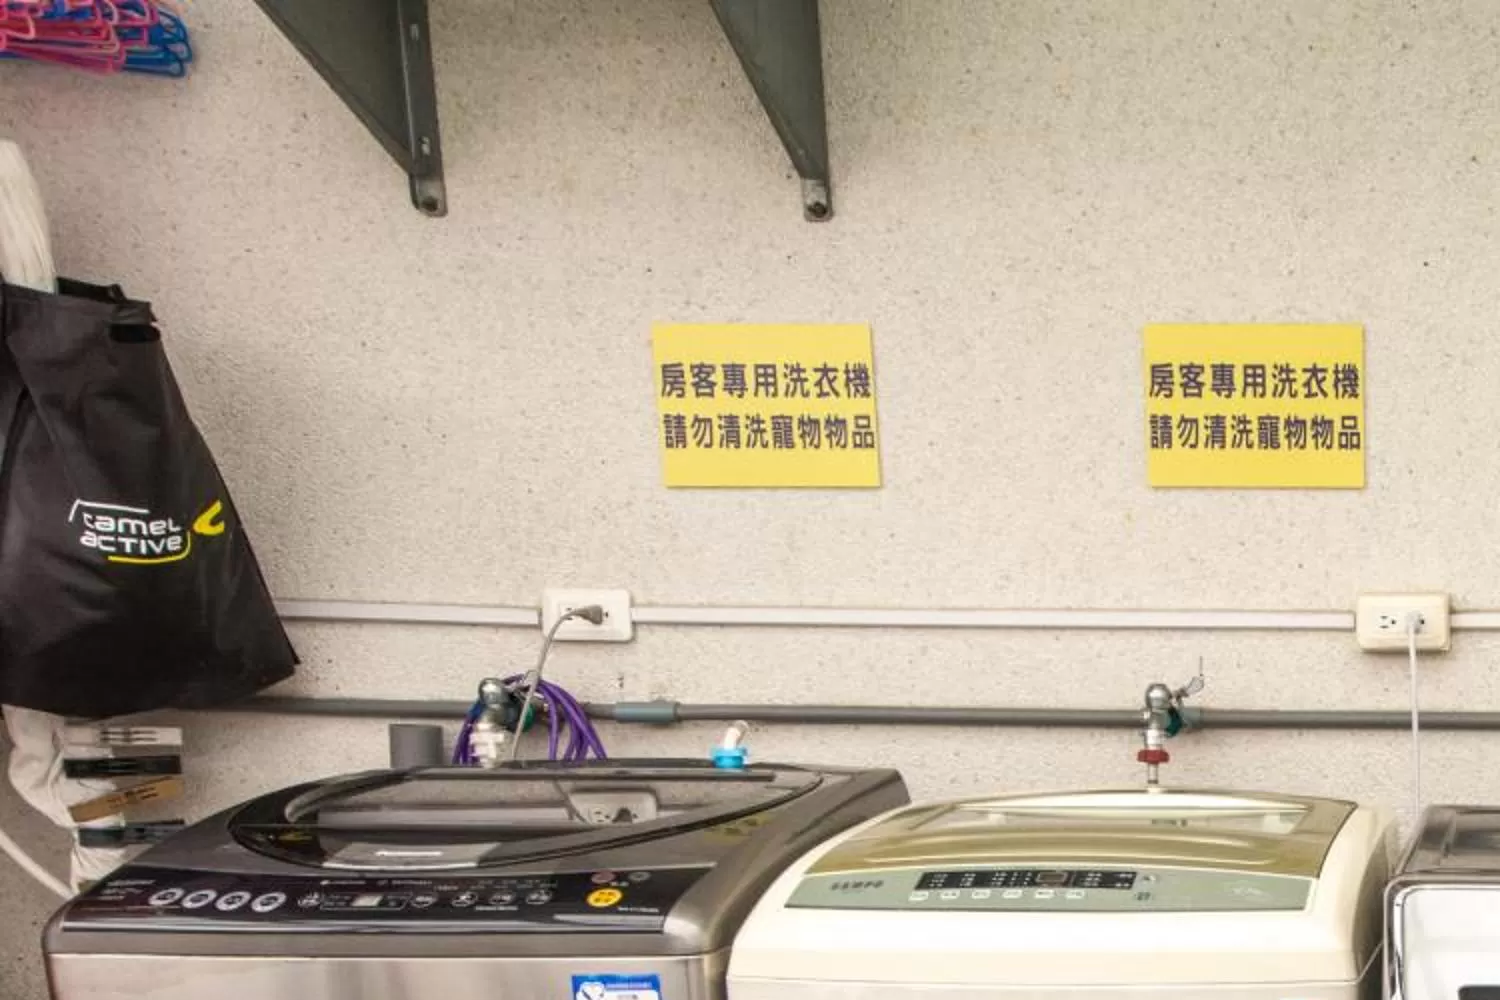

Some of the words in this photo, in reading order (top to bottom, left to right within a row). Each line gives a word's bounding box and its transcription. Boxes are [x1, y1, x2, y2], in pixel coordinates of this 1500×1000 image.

[661, 362, 872, 399] 房客專用洗衣機
[1149, 362, 1360, 399] 房客專用洗衣機
[663, 413, 875, 449] 請勿清洗寵物物品
[1149, 413, 1361, 450] 請勿清洗寵物物品
